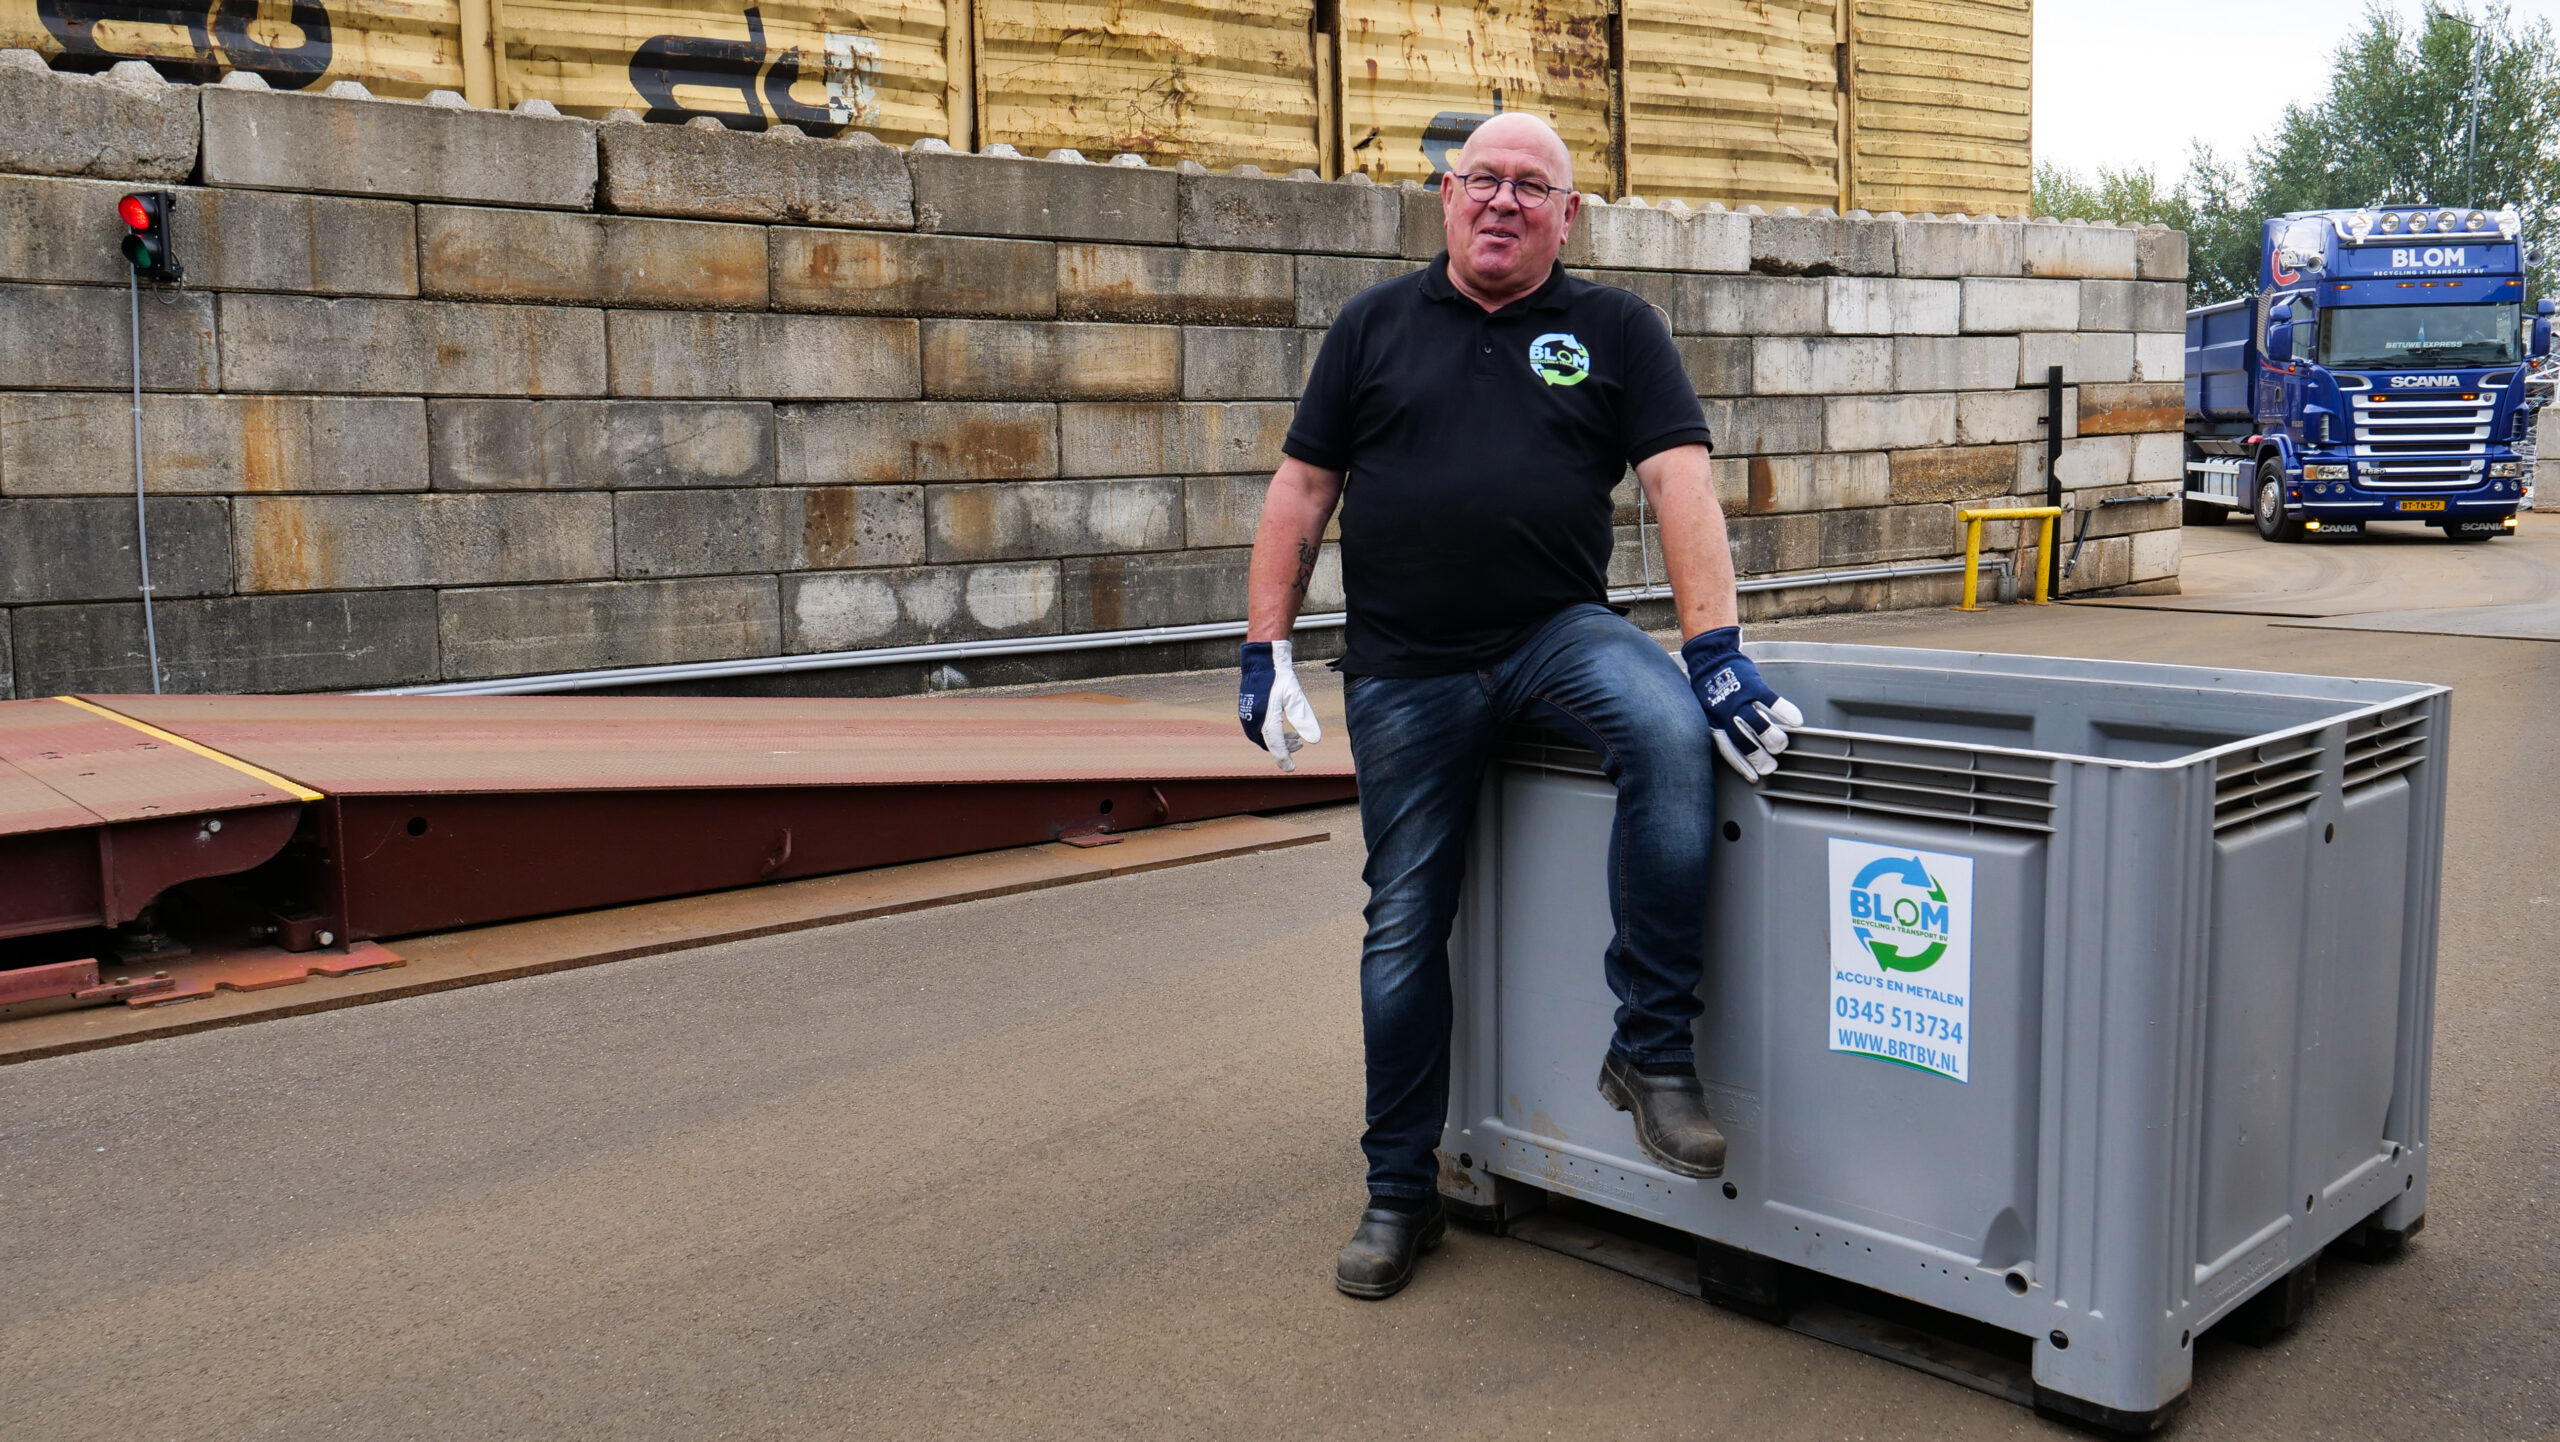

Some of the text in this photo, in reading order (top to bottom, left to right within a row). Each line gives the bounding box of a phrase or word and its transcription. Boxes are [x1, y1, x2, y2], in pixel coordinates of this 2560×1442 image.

[2392, 248, 2465, 268] BLOM
[2385, 341, 2420, 349] BETUWE
[1529, 345, 1590, 372] BLOM
[2391, 375, 2460, 388] SCANIA
[2402, 501, 2440, 510] BT-TN-57
[1850, 889, 1949, 935] BLOM
[1852, 918, 1891, 931] RECYCLING
[1897, 926, 1938, 939] TRANSPORT
[1836, 970, 1964, 1007] ACCU'S EN METALEN
[1836, 995, 1963, 1045] 0345 513734
[1838, 1028, 1960, 1074] WWW.BRTBV.NL
